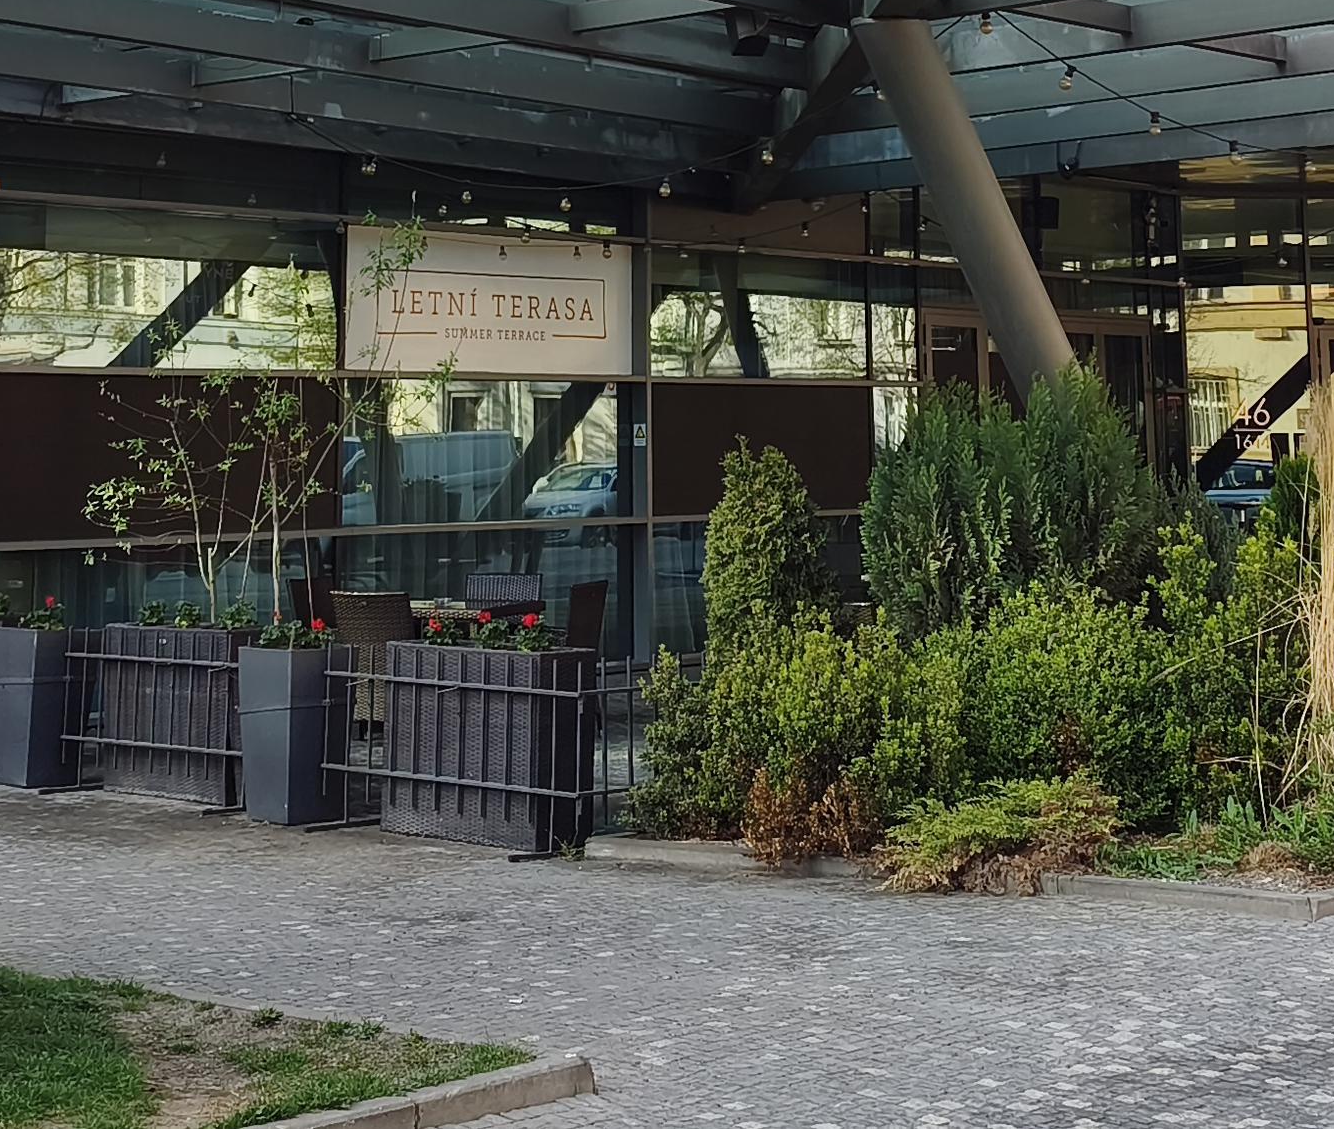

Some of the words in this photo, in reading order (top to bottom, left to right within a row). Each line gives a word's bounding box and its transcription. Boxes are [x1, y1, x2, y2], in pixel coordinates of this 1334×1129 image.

[391, 287, 478, 318] LETNÍ
[491, 294, 595, 321] TERASA
[443, 327, 494, 341] SUMMER
[496, 329, 547, 342] TERRACE
[1230, 397, 1271, 426] 46
